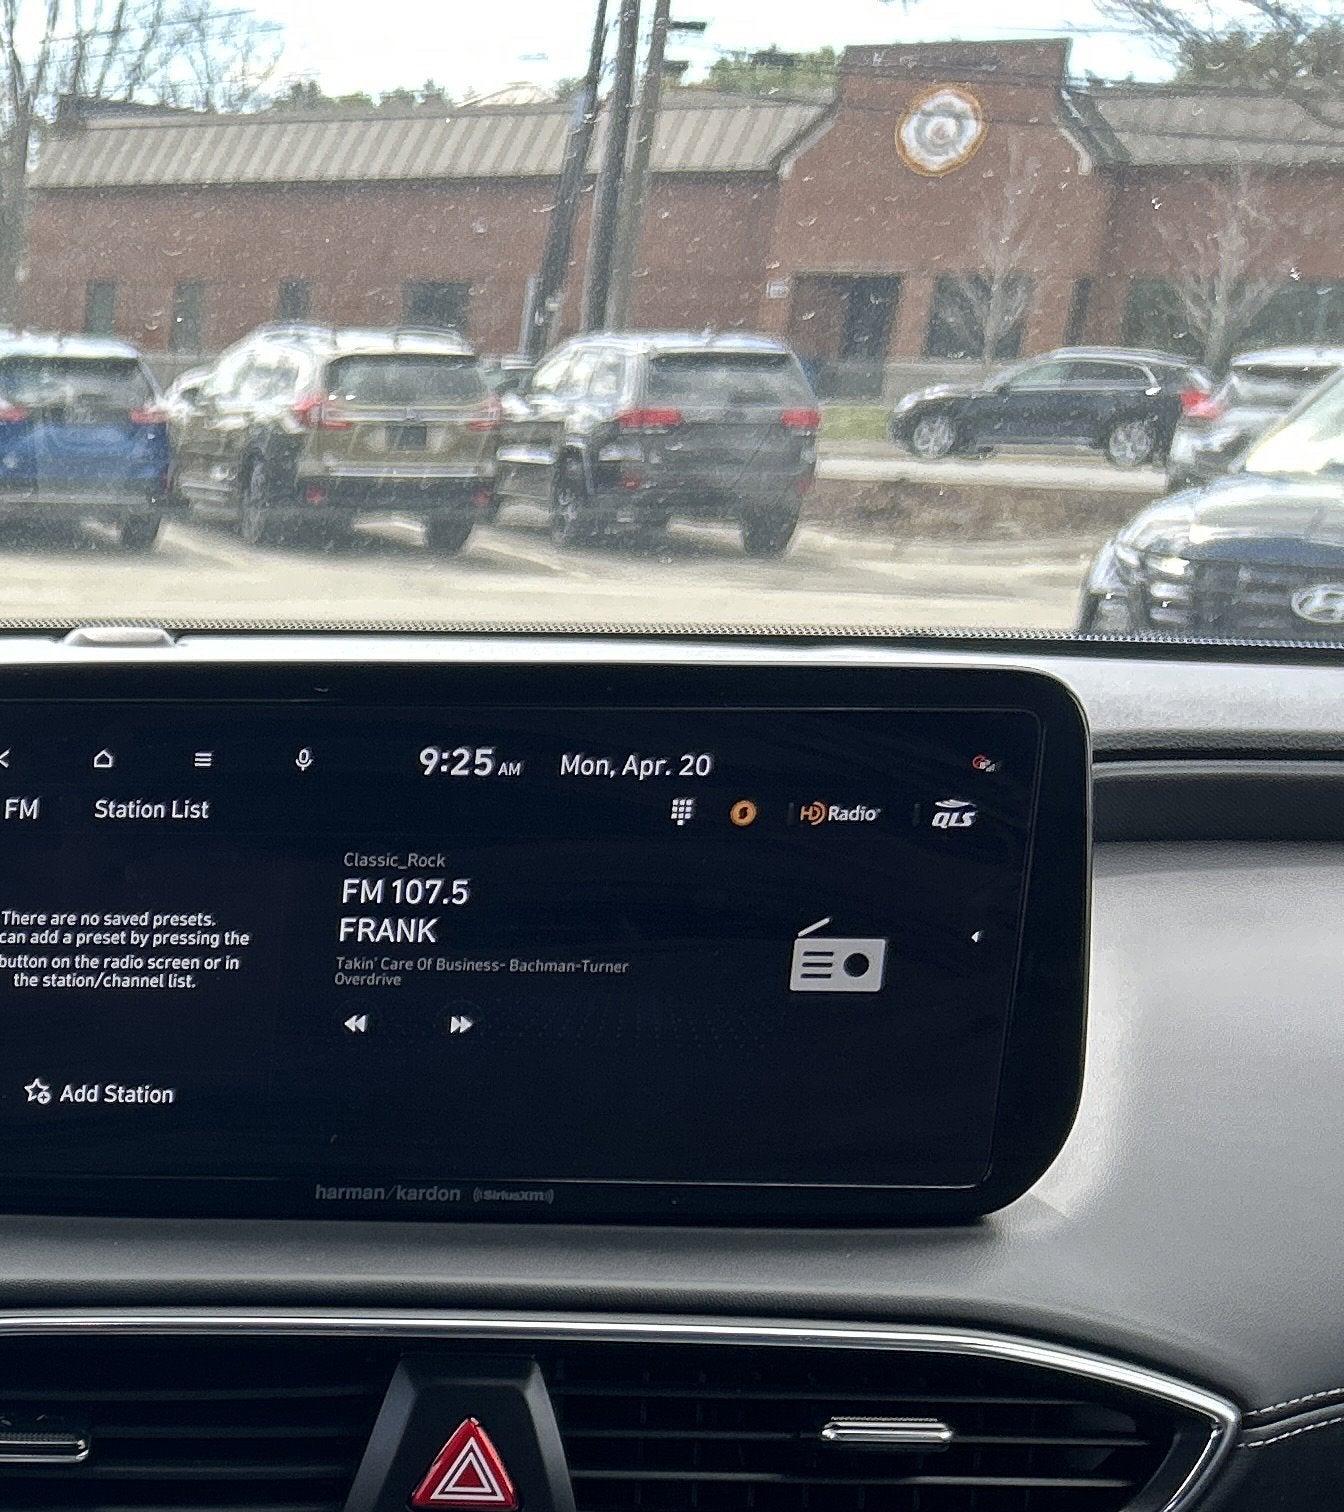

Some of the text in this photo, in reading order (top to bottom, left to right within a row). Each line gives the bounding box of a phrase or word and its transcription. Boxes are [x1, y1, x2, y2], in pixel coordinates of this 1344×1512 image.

[419, 746, 523, 776] 9:25 AM
[561, 754, 713, 780] Mon, Apr. 20
[4, 798, 40, 820] FM
[94, 798, 210, 819] Station List
[828, 804, 878, 822] Radio
[931, 811, 976, 829] QLS
[343, 852, 446, 868] Classic_Rock
[342, 878, 470, 904] FM 107.5
[1, 910, 216, 928] There are no saved presets.
[0, 934, 26, 944] can
[30, 930, 57, 944] add
[62, 934, 72, 944] a
[76, 932, 126, 947] preset
[130, 931, 148, 948] by
[153, 932, 220, 948] pressing
[224, 931, 250, 946] the
[338, 917, 440, 943] FRANK
[51, 958, 70, 969] on
[74, 954, 99, 969] the
[104, 955, 144, 970] radio
[147, 958, 200, 970] screen
[204, 959, 222, 970] or
[226, 955, 240, 970] in
[336, 956, 630, 974] Takin' Care Of Business- Bachman-Turner
[13, 972, 196, 989] the station/channel list.
[334, 972, 402, 986] Overdrive
[60, 1084, 175, 1104] Add Station
[315, 1184, 461, 1201] harman/kardon
